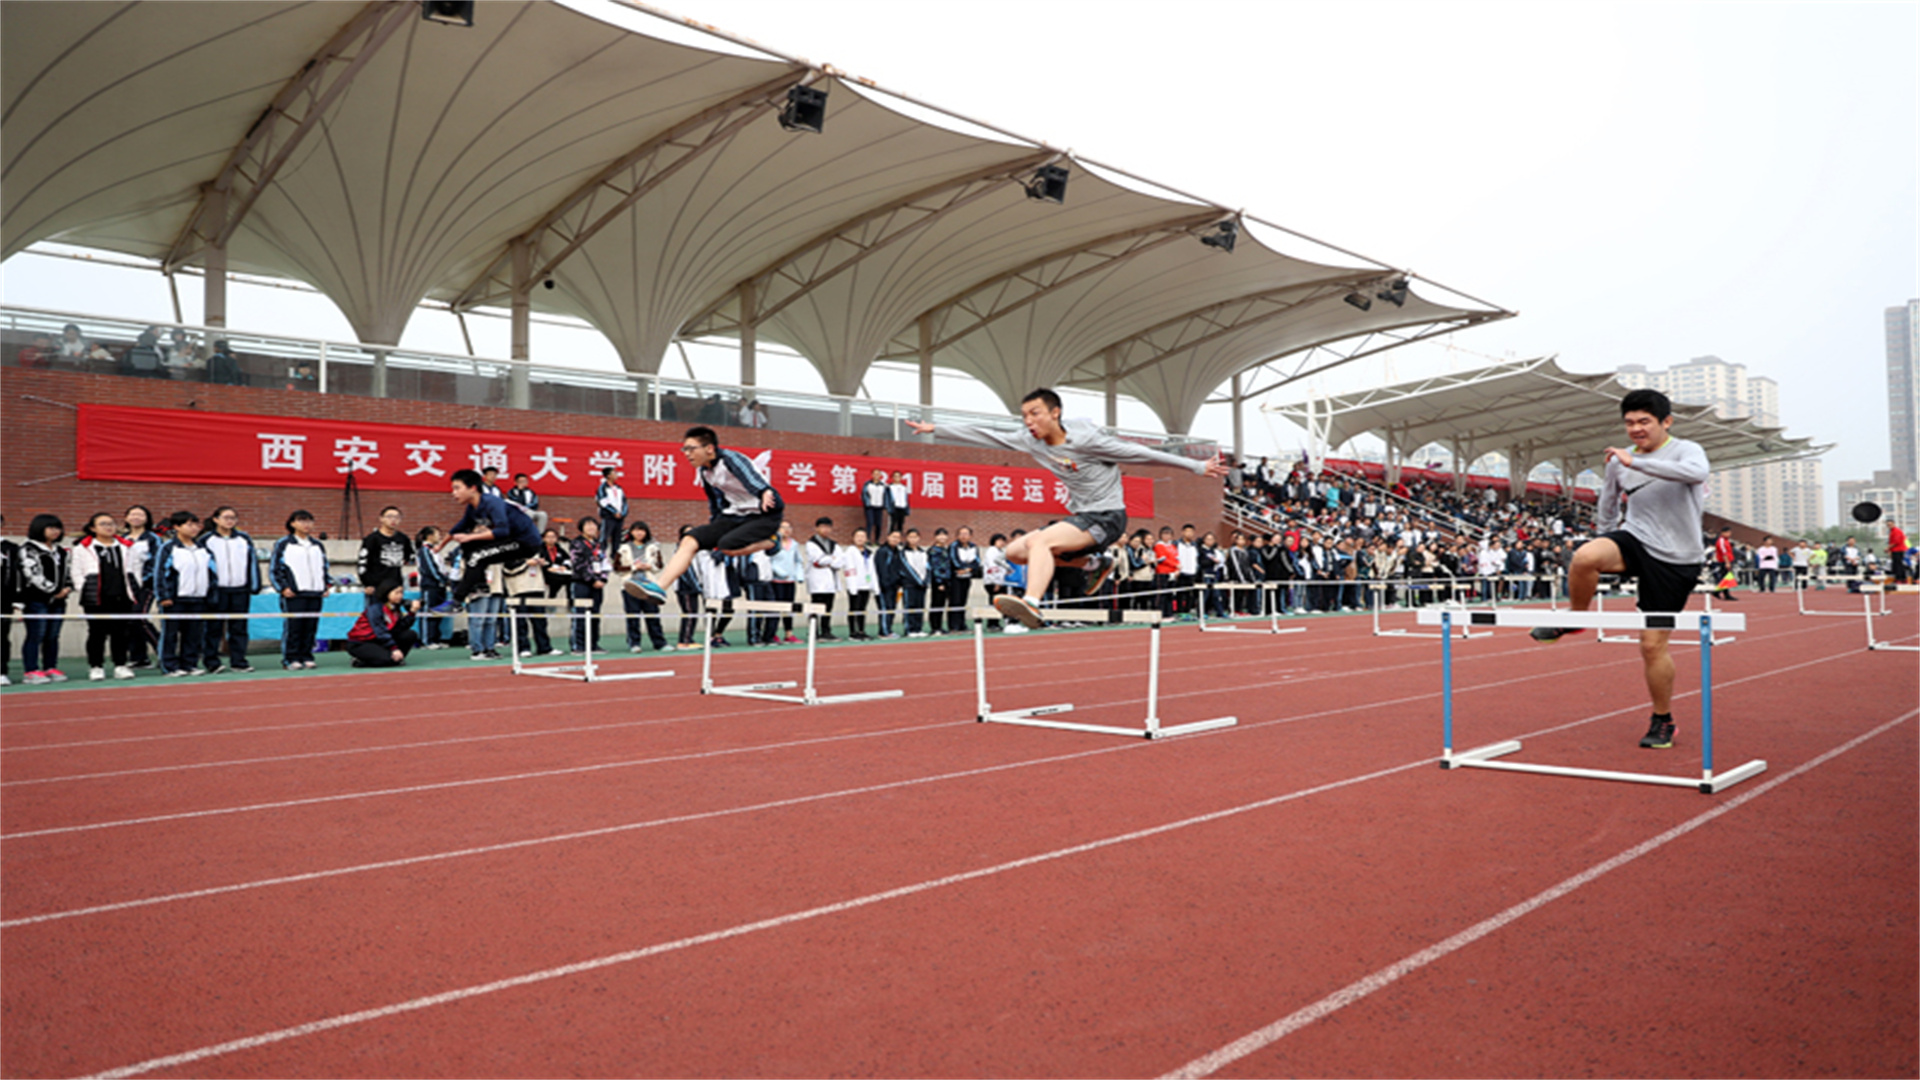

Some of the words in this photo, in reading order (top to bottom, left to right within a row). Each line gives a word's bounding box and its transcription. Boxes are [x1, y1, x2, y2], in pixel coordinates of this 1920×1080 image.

[256, 431, 1071, 504] 西安交通大学附学第1届田径运动
